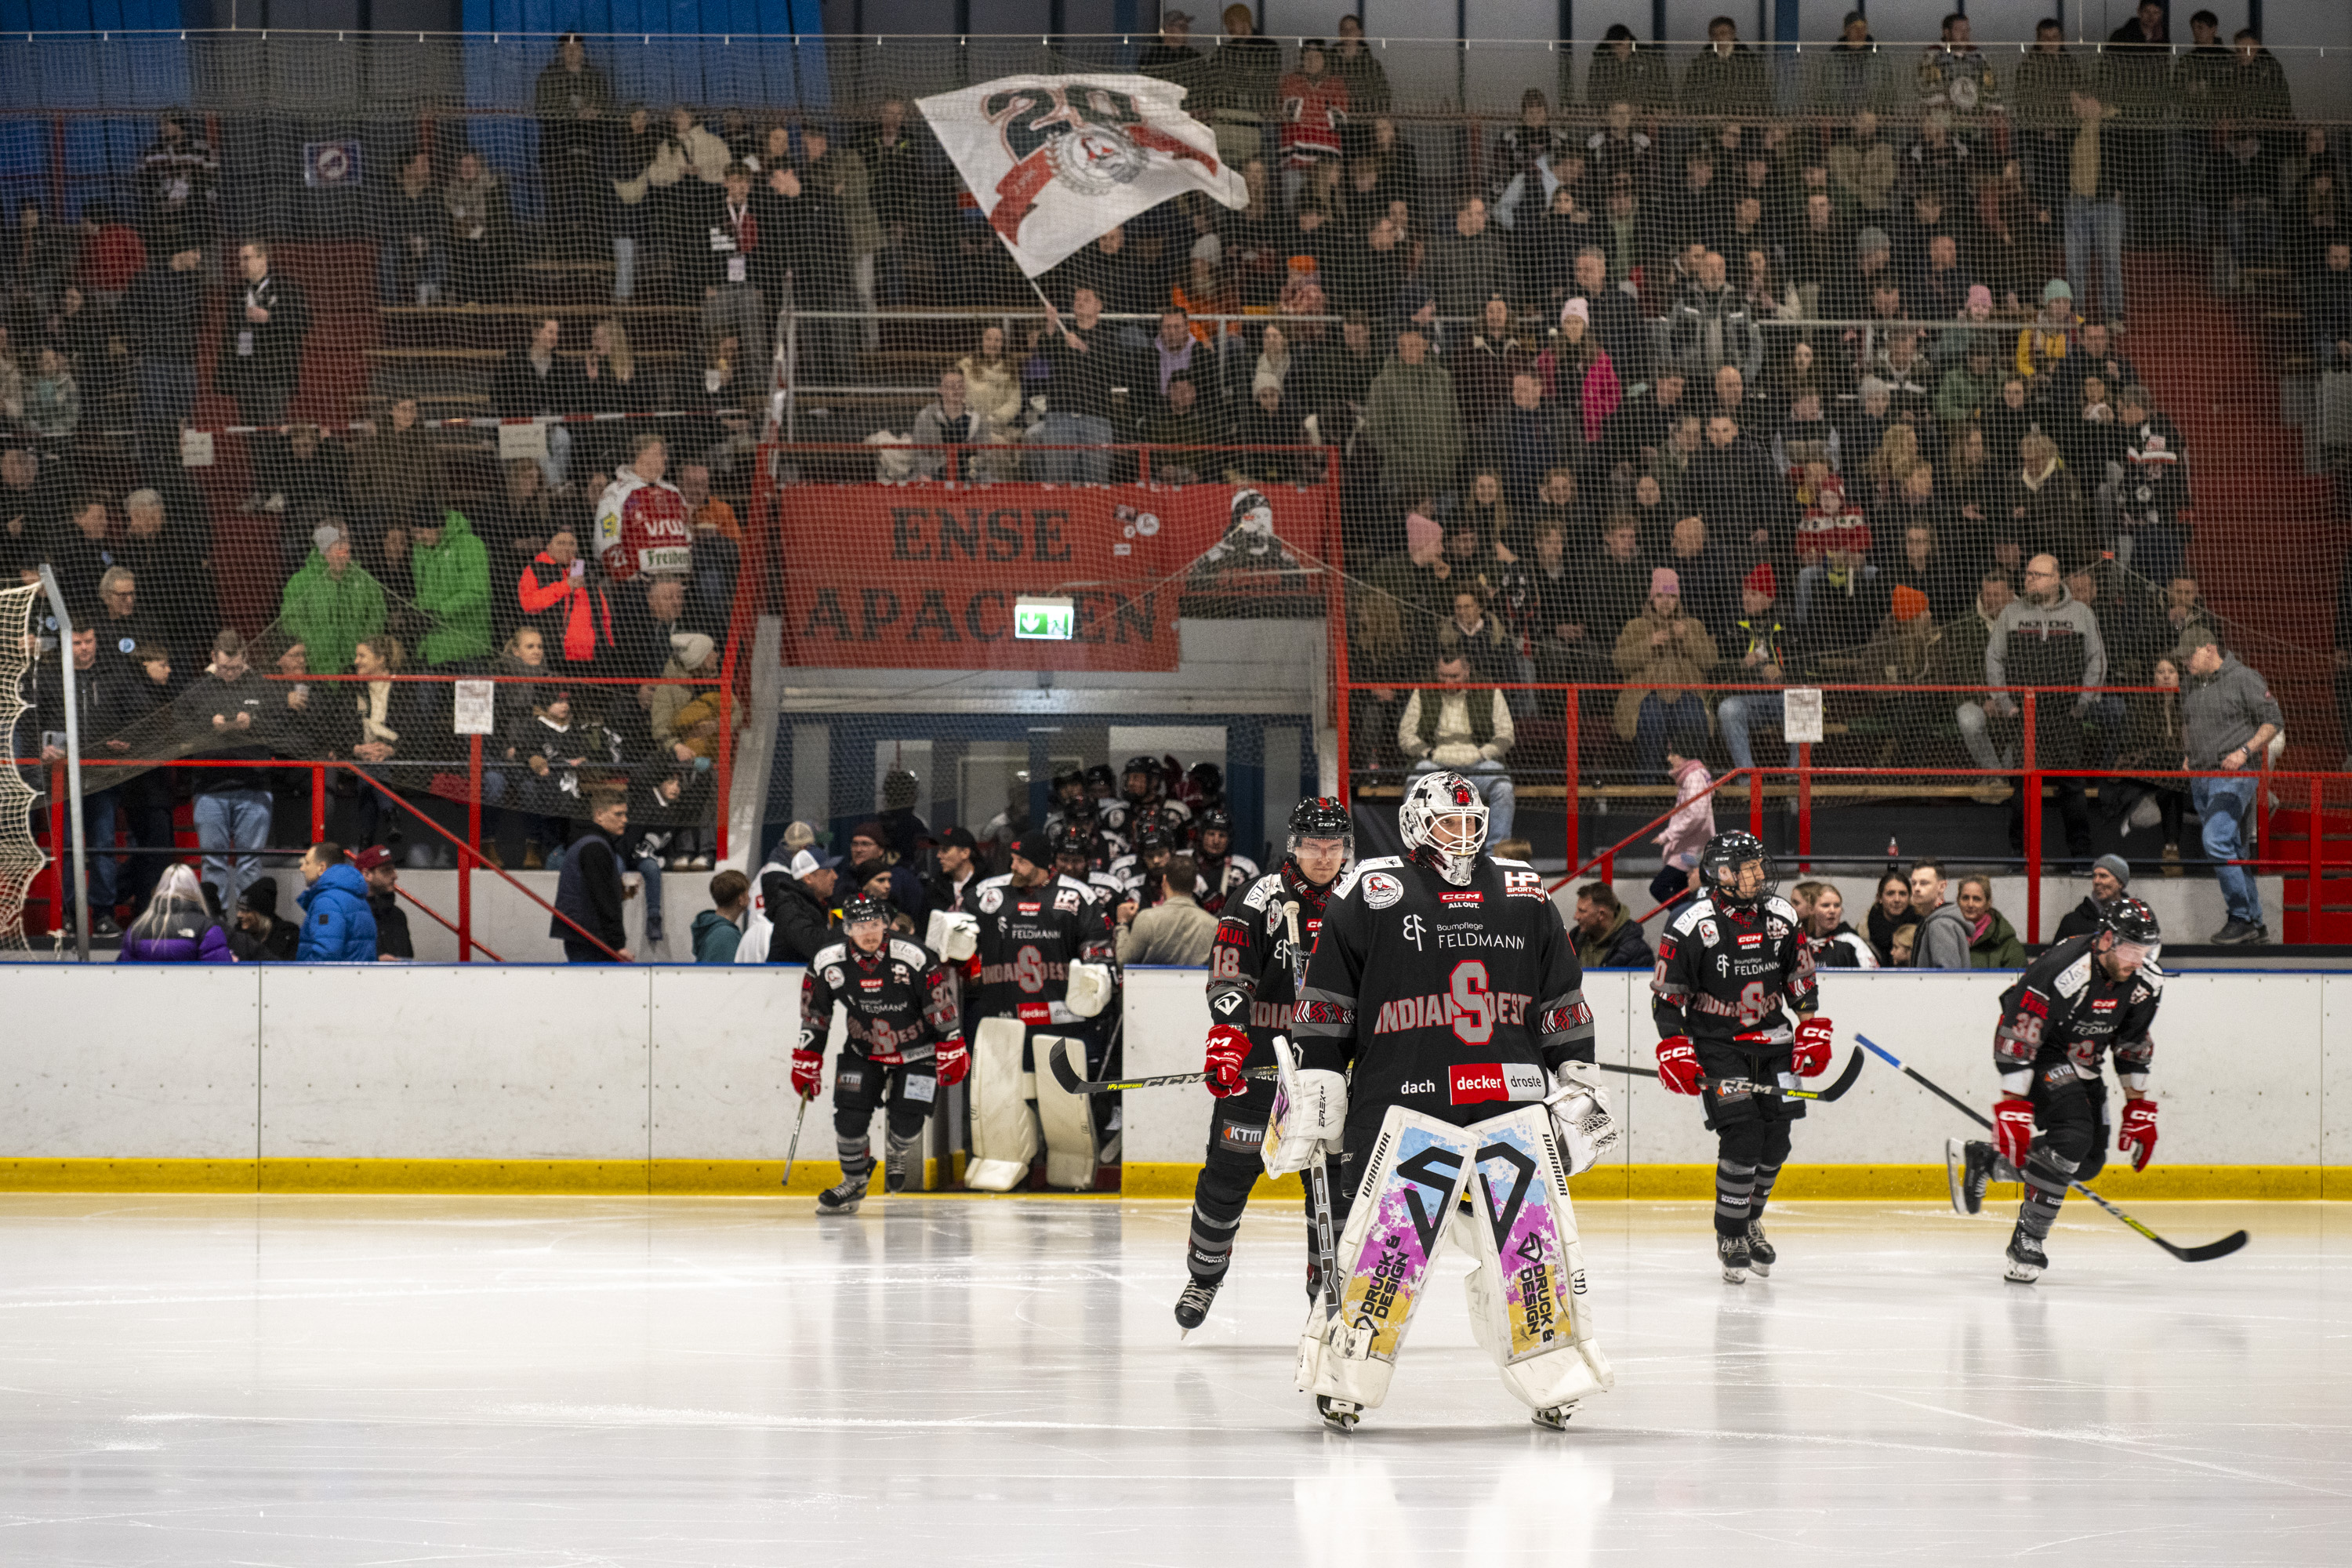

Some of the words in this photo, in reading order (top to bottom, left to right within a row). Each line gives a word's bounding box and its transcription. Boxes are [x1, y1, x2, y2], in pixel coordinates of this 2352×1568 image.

[891, 506, 1072, 562] ENSE
[802, 587, 1157, 644] APACEN
[1437, 922, 1483, 931] Baumpflege
[1438, 933, 1525, 950] FELDMANN
[1214, 946, 1240, 978] 18
[1021, 1008, 1048, 1019] decker
[1803, 1027, 1831, 1040] CC
[2012, 1013, 2043, 1044] 36
[792, 1061, 818, 1069] CM
[1143, 1074, 1207, 1088] CCM
[1401, 1079, 1436, 1094] dach
[1457, 1075, 1501, 1091] decker
[1510, 1073, 1541, 1088] droste
[1720, 1080, 1773, 1094] CCM
[1999, 1110, 2034, 1123] CC
[2130, 1109, 2157, 1122] CC
[1229, 1126, 1262, 1142] KTM
[1363, 1132, 1391, 1198] WARRIOR
[1542, 1134, 1567, 1196] WARRIOR
[1313, 1166, 1338, 1307] CCM
[1196, 1254, 1226, 1263] BANNAT
[1360, 1250, 1395, 1315] DRUCK
[1386, 1235, 1401, 1249] &
[1374, 1251, 1410, 1319] DESIGN
[1521, 1268, 1541, 1335] DESIGN
[1534, 1263, 1553, 1327] DRUCK
[1542, 1329, 1554, 1342] &
